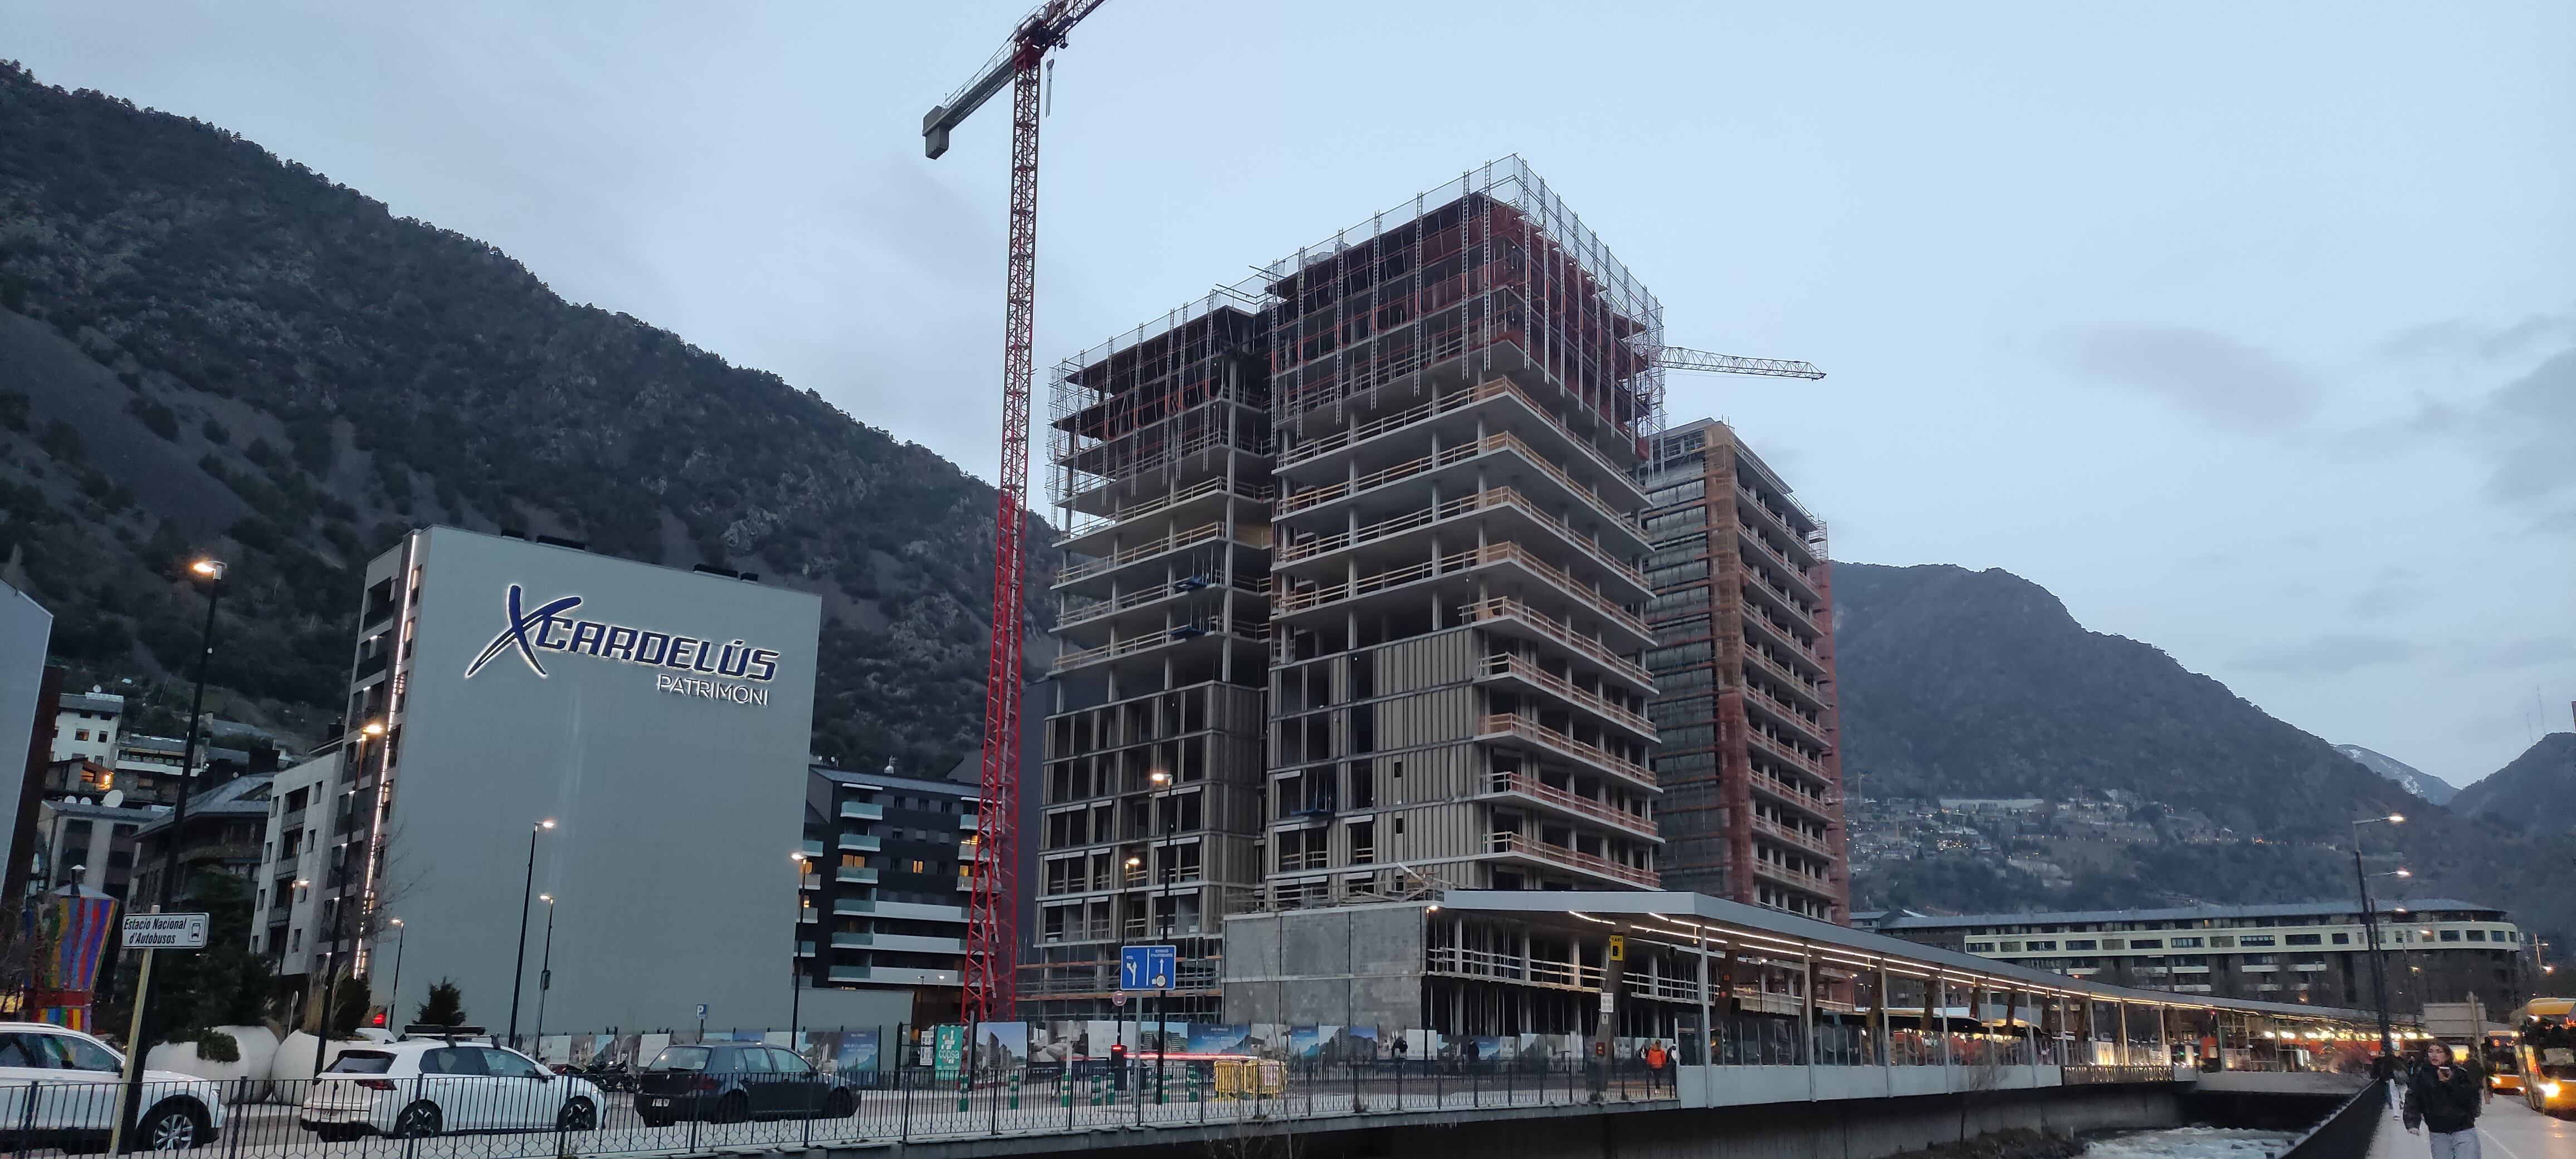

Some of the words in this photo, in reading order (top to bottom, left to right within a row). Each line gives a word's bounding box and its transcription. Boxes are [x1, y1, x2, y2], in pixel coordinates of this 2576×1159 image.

[657, 674, 769, 707] PATRIMONI
[123, 918, 151, 930] Estació
[152, 917, 187, 930] Nacional
[129, 932, 176, 944] d'Autobusos
[697, 1005, 704, 1017] P
[939, 1050, 959, 1061] copsa
